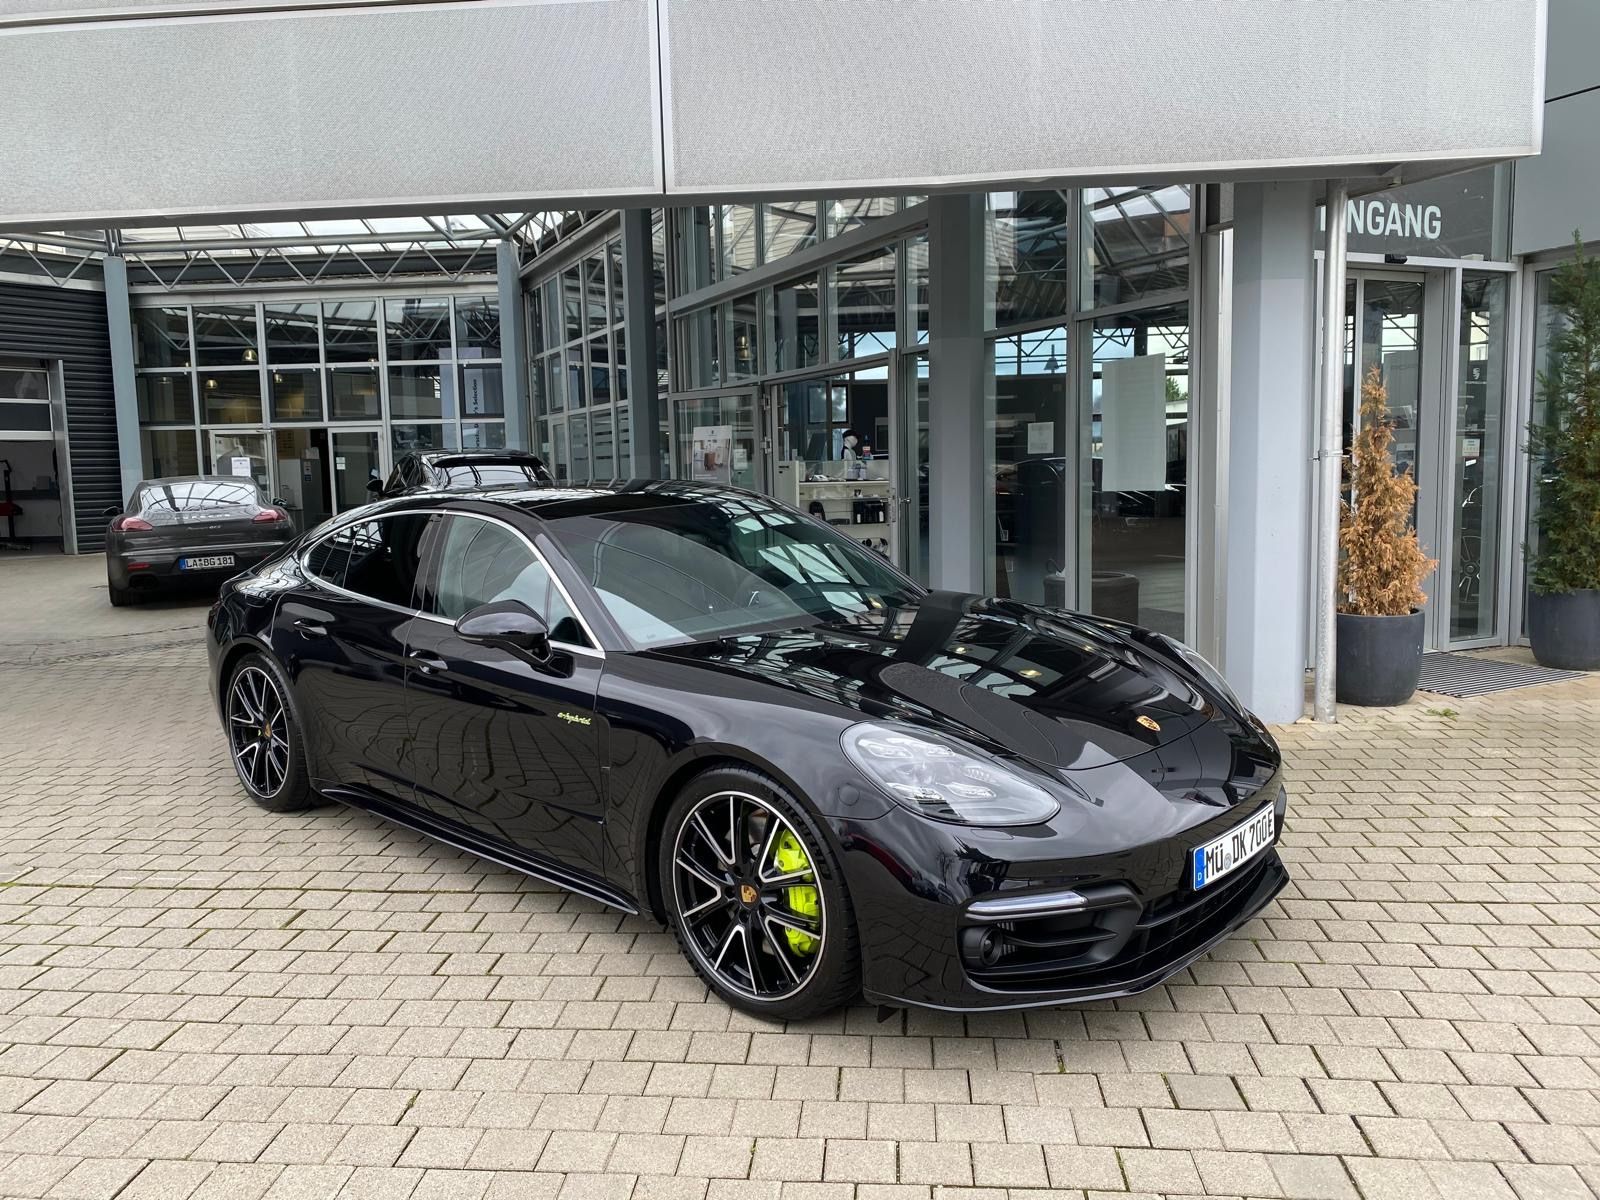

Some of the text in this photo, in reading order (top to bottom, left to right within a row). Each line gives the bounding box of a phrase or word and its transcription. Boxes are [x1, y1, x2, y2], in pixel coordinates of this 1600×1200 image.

[186, 558, 198, 568] LA
[203, 557, 216, 567] BG
[217, 556, 233, 566] 181
[1205, 810, 1274, 879] MÜ DK 700E
